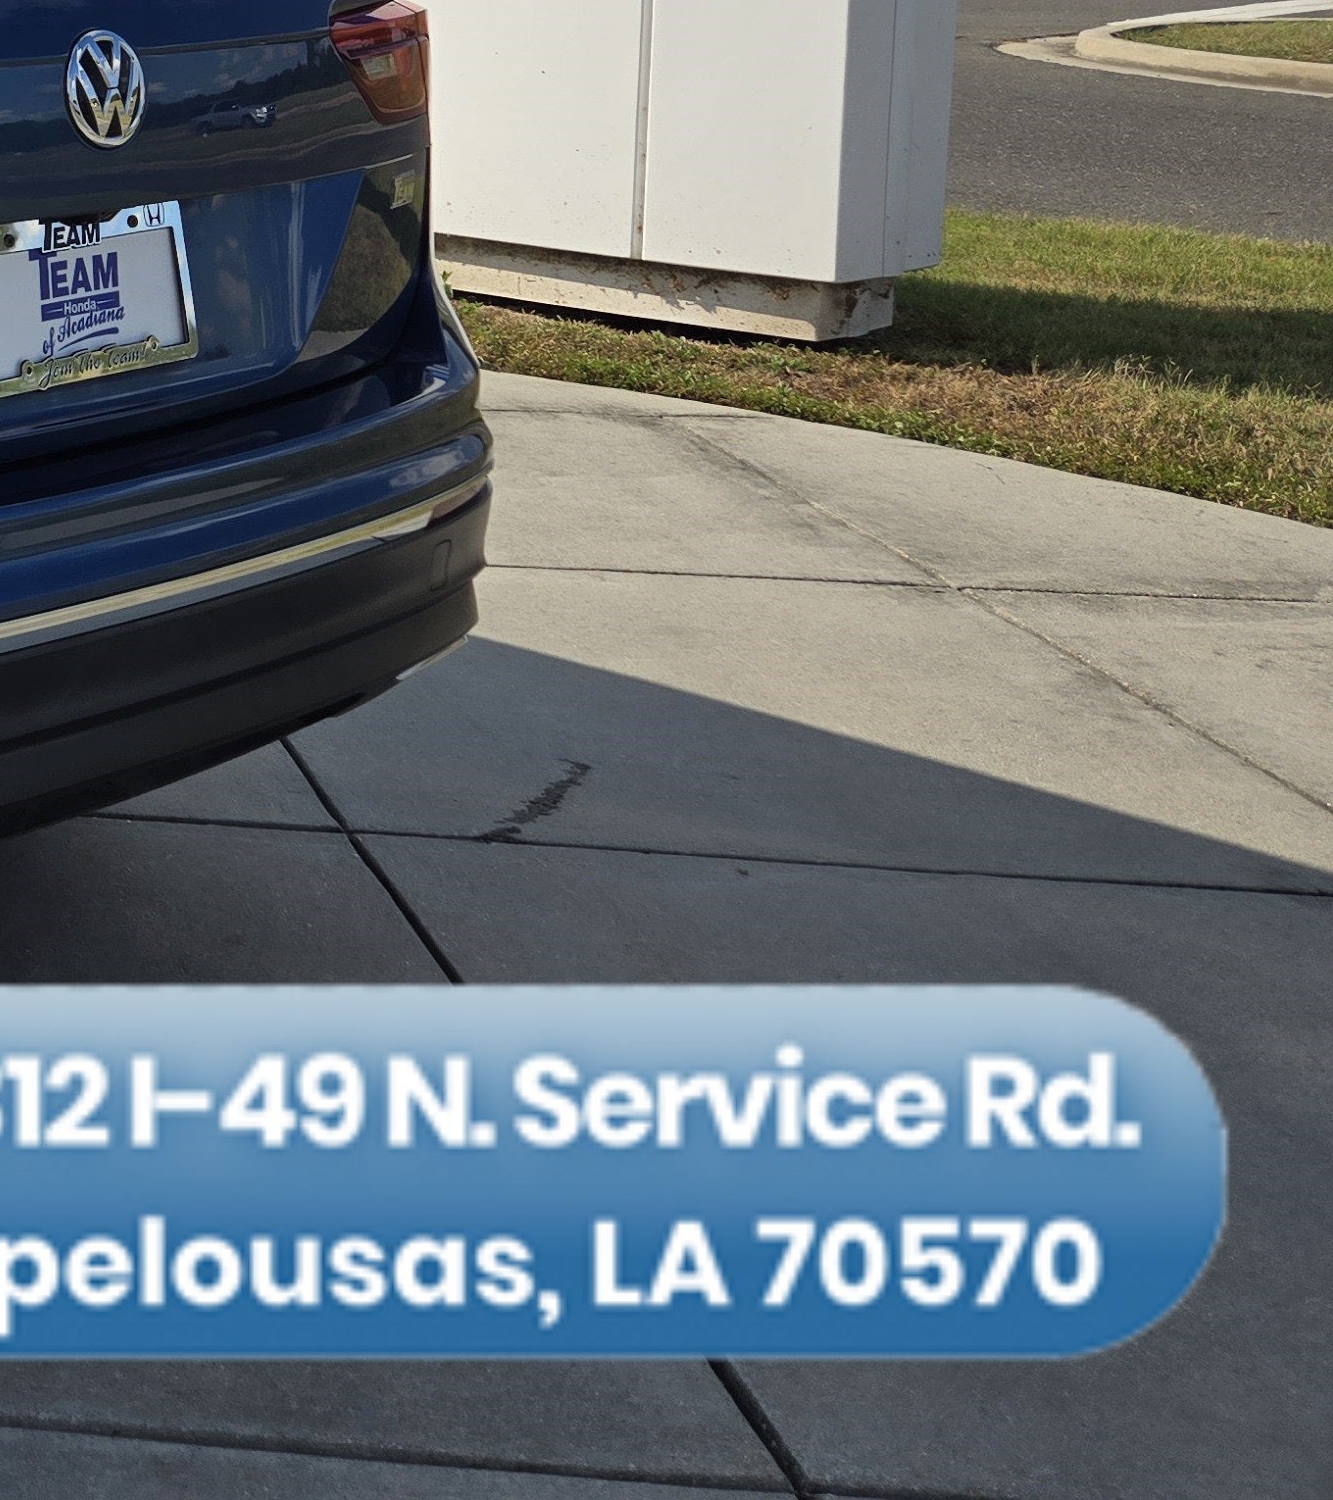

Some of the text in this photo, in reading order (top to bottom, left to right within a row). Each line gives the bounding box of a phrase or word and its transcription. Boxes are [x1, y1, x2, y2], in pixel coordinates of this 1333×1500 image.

[38, 218, 102, 252] TEAM
[29, 249, 120, 300] TEAM
[63, 299, 97, 317] Honda
[42, 305, 126, 357] of Acadiana
